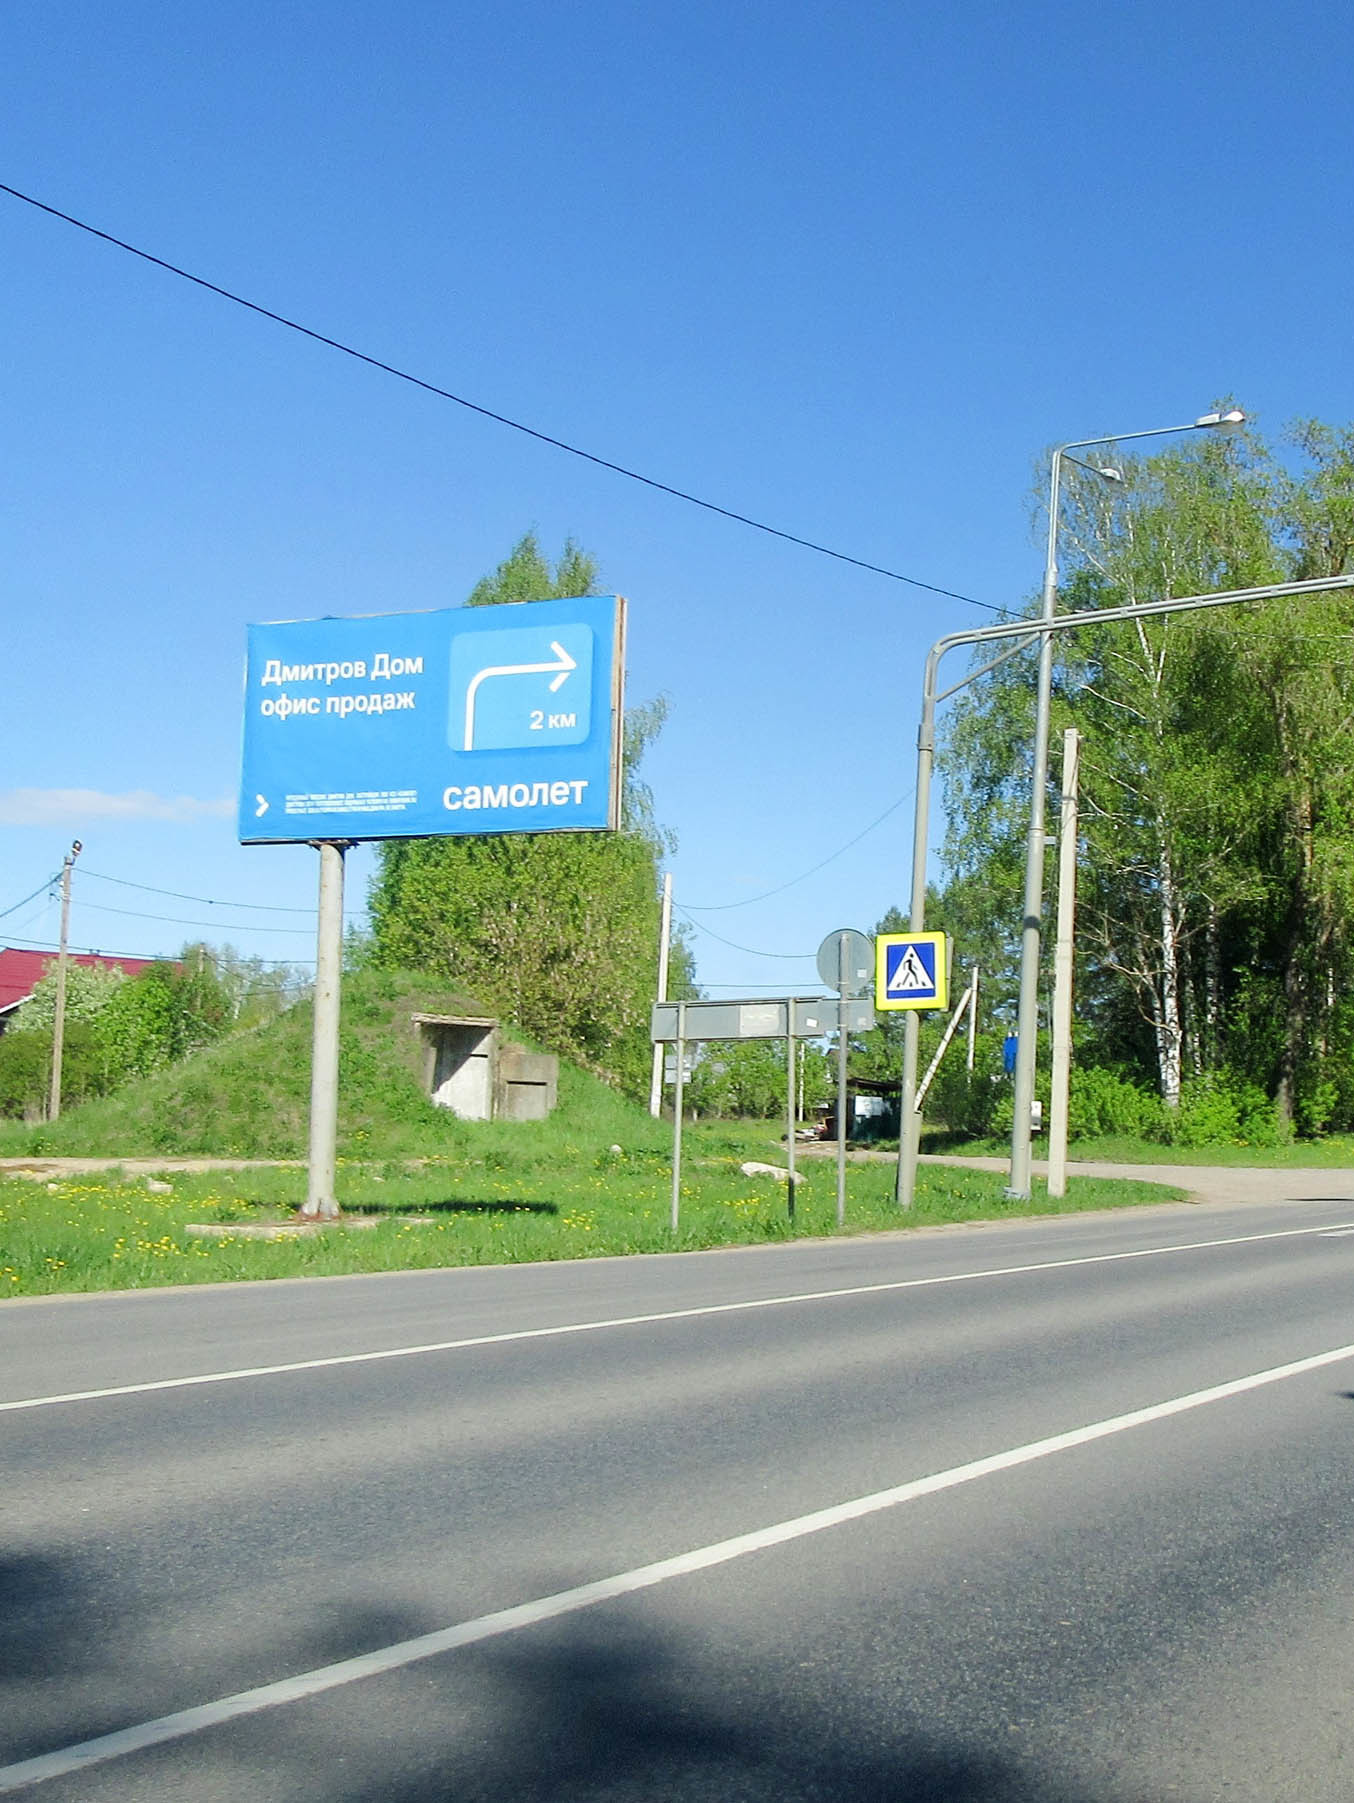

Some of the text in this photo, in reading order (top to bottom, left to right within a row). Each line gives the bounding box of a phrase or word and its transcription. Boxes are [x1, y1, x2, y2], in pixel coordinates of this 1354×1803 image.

[261, 653, 424, 687] Дмитров Дом
[260, 691, 416, 721] офис продаж
[529, 710, 577, 730] 2 км
[442, 780, 589, 811] самолет
